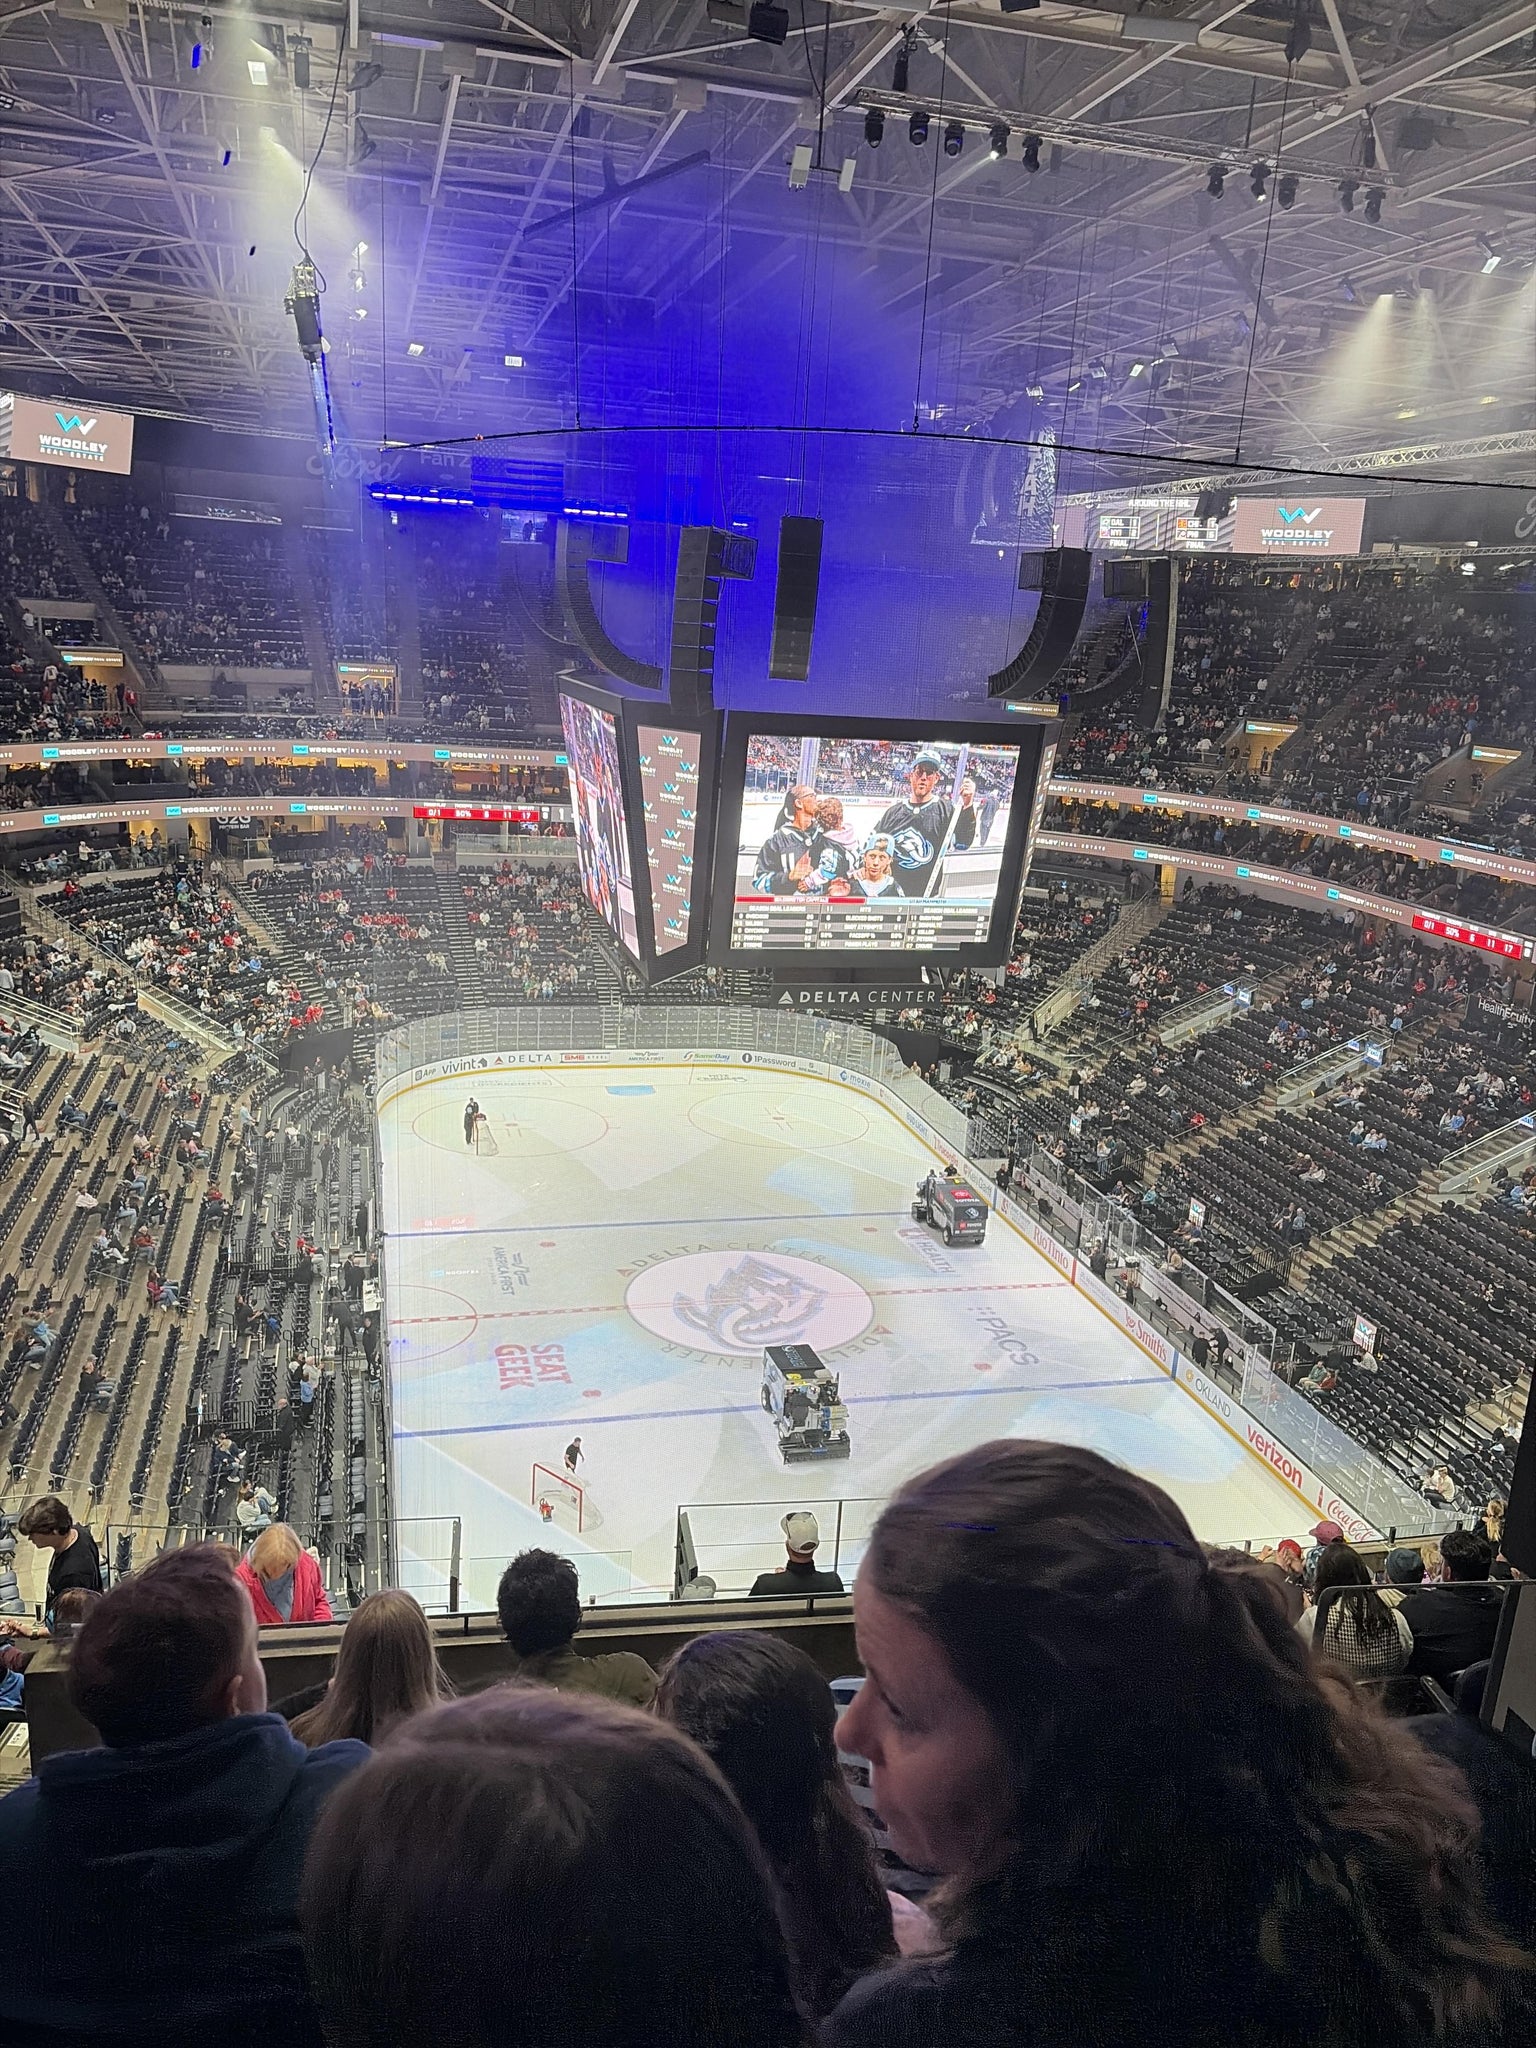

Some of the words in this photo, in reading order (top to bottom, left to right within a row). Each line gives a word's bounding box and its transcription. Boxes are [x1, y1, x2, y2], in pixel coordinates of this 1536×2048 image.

[39, 434, 108, 454] WOODLEY
[1261, 528, 1334, 538] WOODLEY
[450, 751, 488, 759] WOODLEY
[1157, 797, 1190, 806] WOODLEY
[59, 812, 97, 821] WOODLEY
[1148, 852, 1180, 862] WOODLEY
[1454, 854, 1487, 866] WOODLEY
[1487, 938, 1496, 948] 11
[1504, 943, 1513, 953] 17
[800, 991, 860, 1003] DELTA
[867, 991, 936, 1003] CENTER
[508, 1054, 552, 1063] DELTA
[754, 1055, 797, 1068] 1Password
[630, 1243, 712, 1268] DELTA
[976, 1316, 1040, 1367] PACS
[1137, 1318, 1168, 1363] Smith's
[494, 1344, 535, 1390] GEEK
[530, 1343, 573, 1385] SEAT
[1195, 1378, 1231, 1418] OKLAND
[1247, 1424, 1303, 1490] verizon
